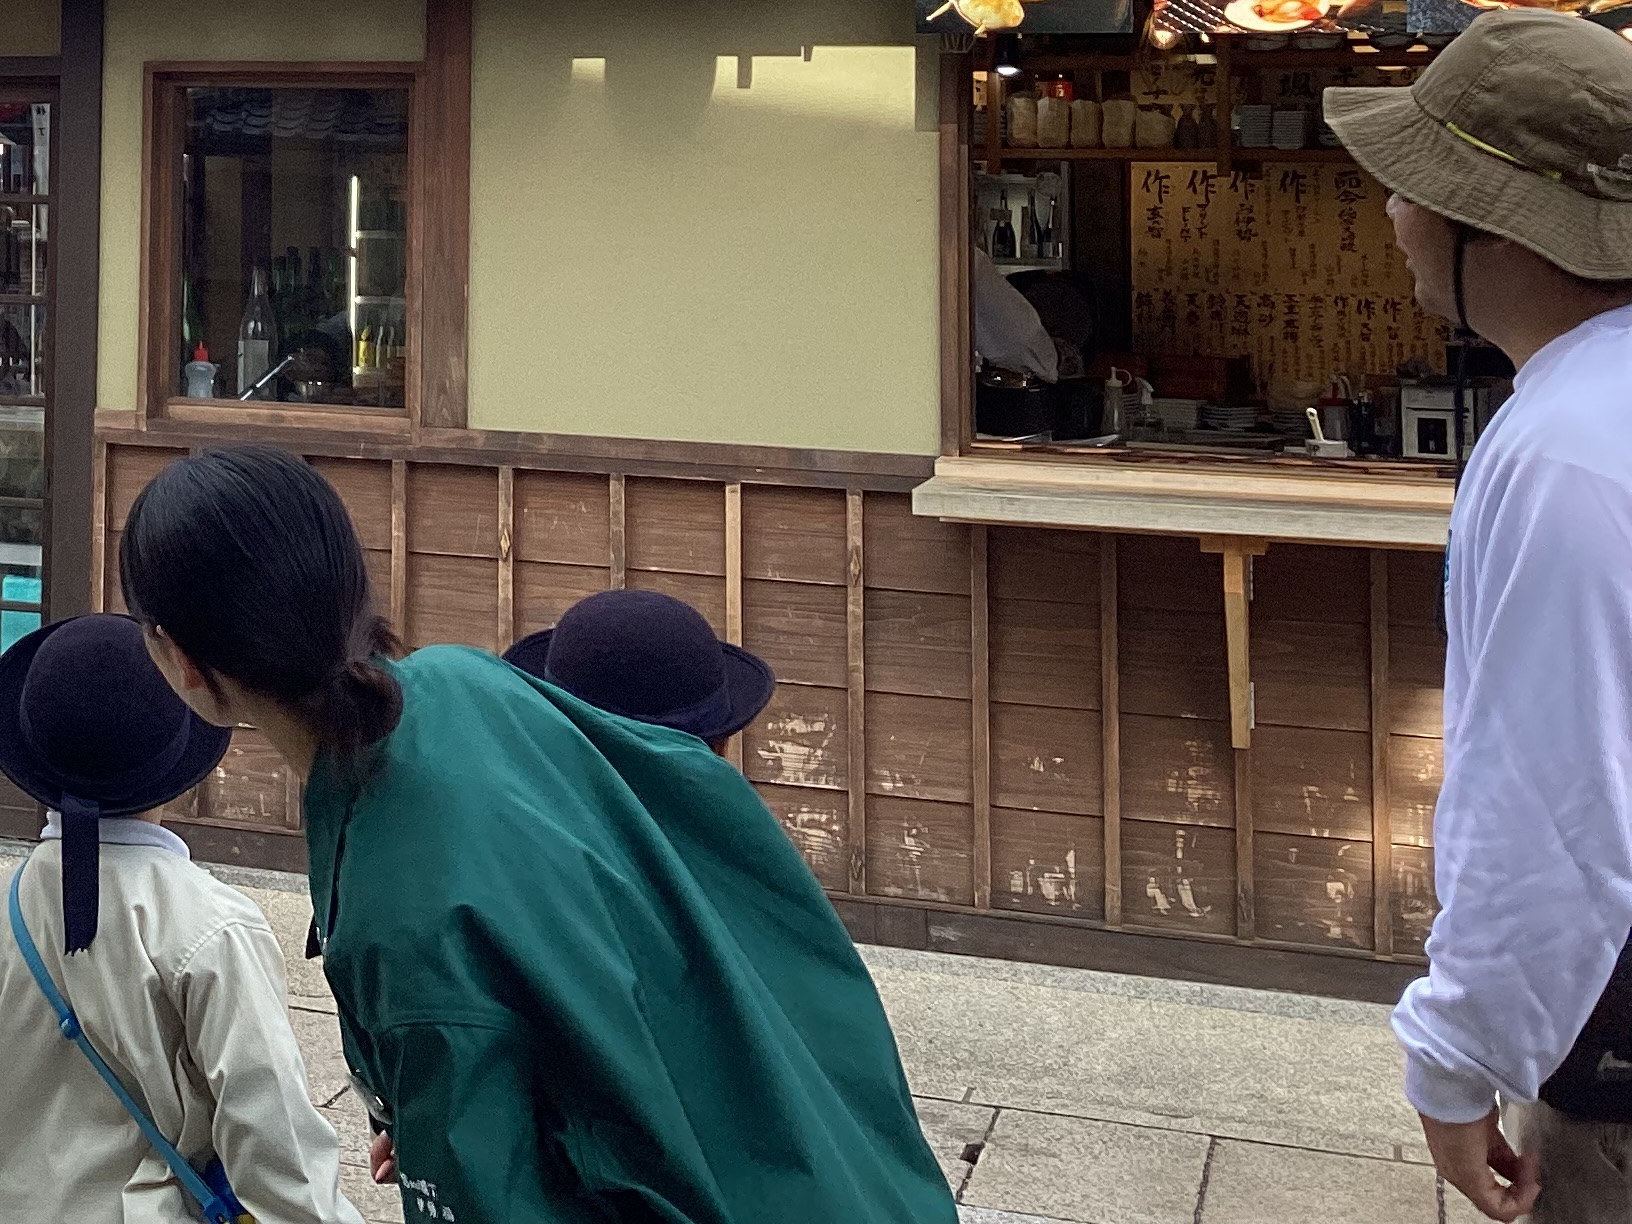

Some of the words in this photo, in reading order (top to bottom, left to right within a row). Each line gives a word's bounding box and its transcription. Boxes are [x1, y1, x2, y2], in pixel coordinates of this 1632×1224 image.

[1141, 169, 1171, 204] 作
[1186, 169, 1218, 204] 作
[1279, 169, 1307, 204] 作
